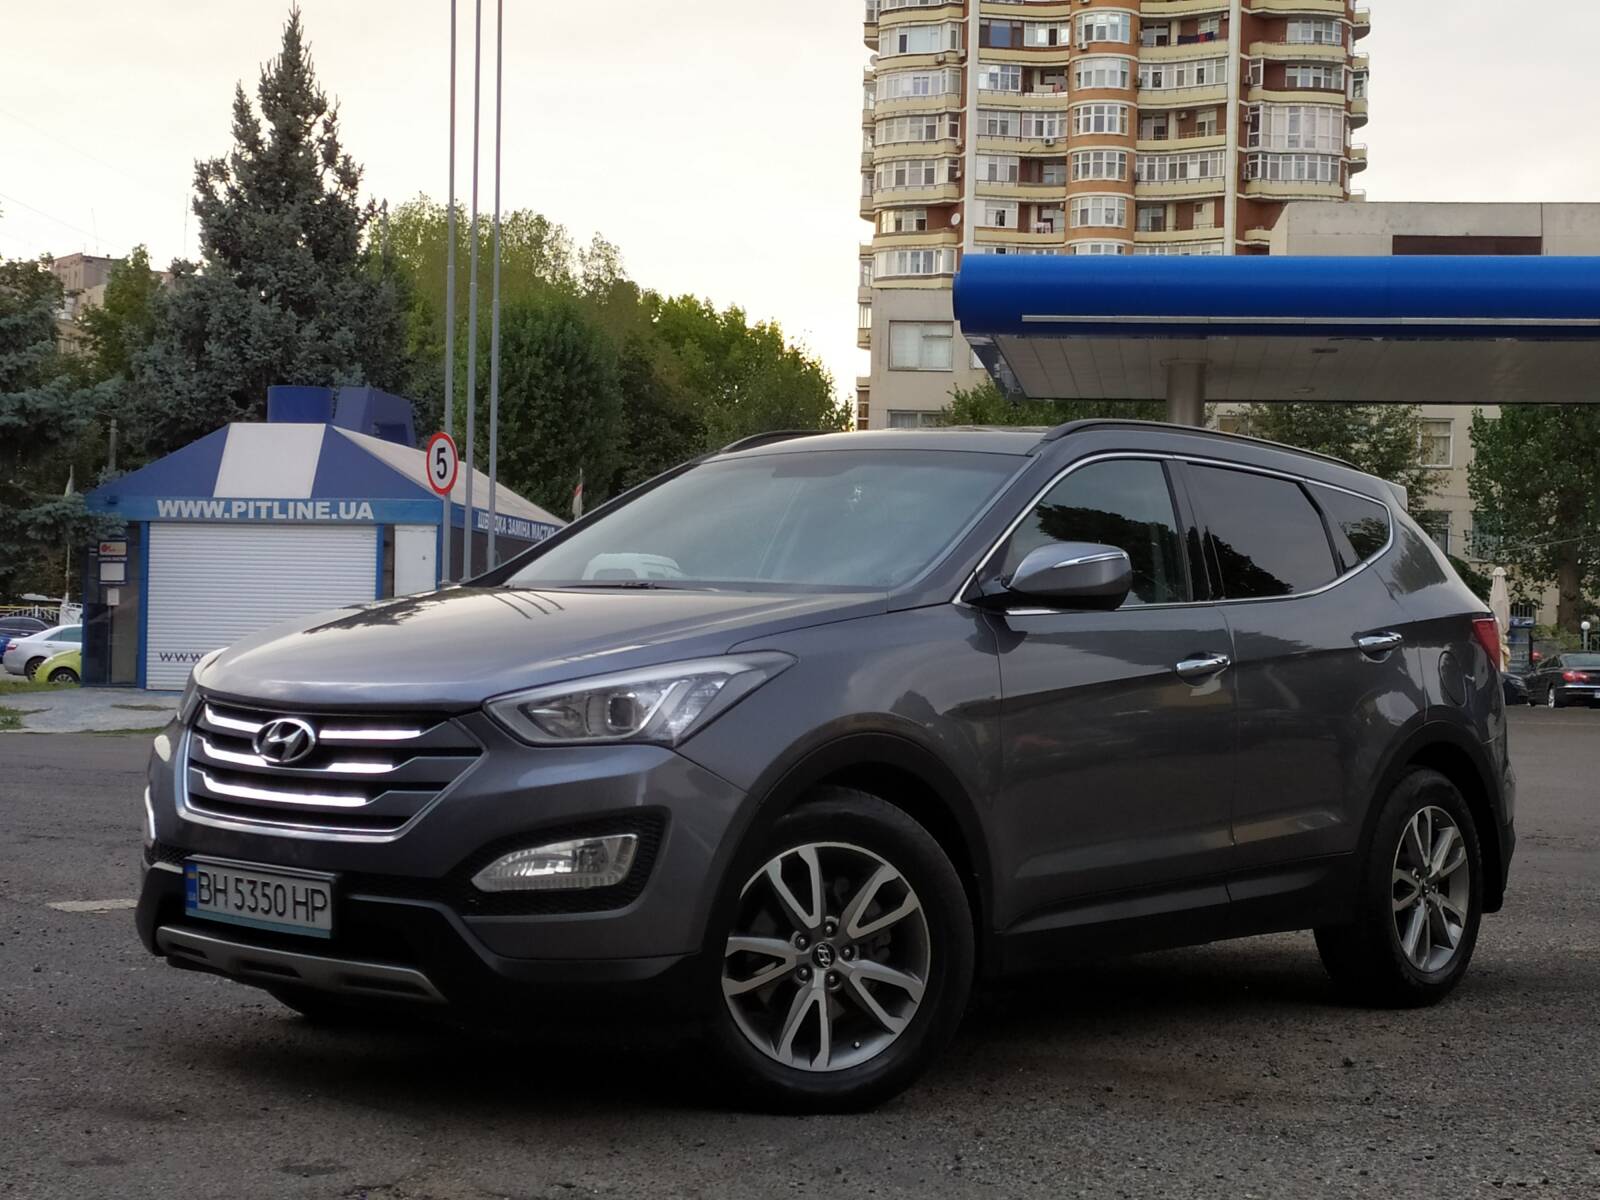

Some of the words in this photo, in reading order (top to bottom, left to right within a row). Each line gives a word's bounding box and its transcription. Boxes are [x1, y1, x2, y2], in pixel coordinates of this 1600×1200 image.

[436, 447, 447, 480] 5
[156, 500, 374, 520] WWW.PITLINE.UA
[198, 871, 228, 909] BH
[234, 877, 287, 917] 5350
[292, 885, 328, 922] HP
